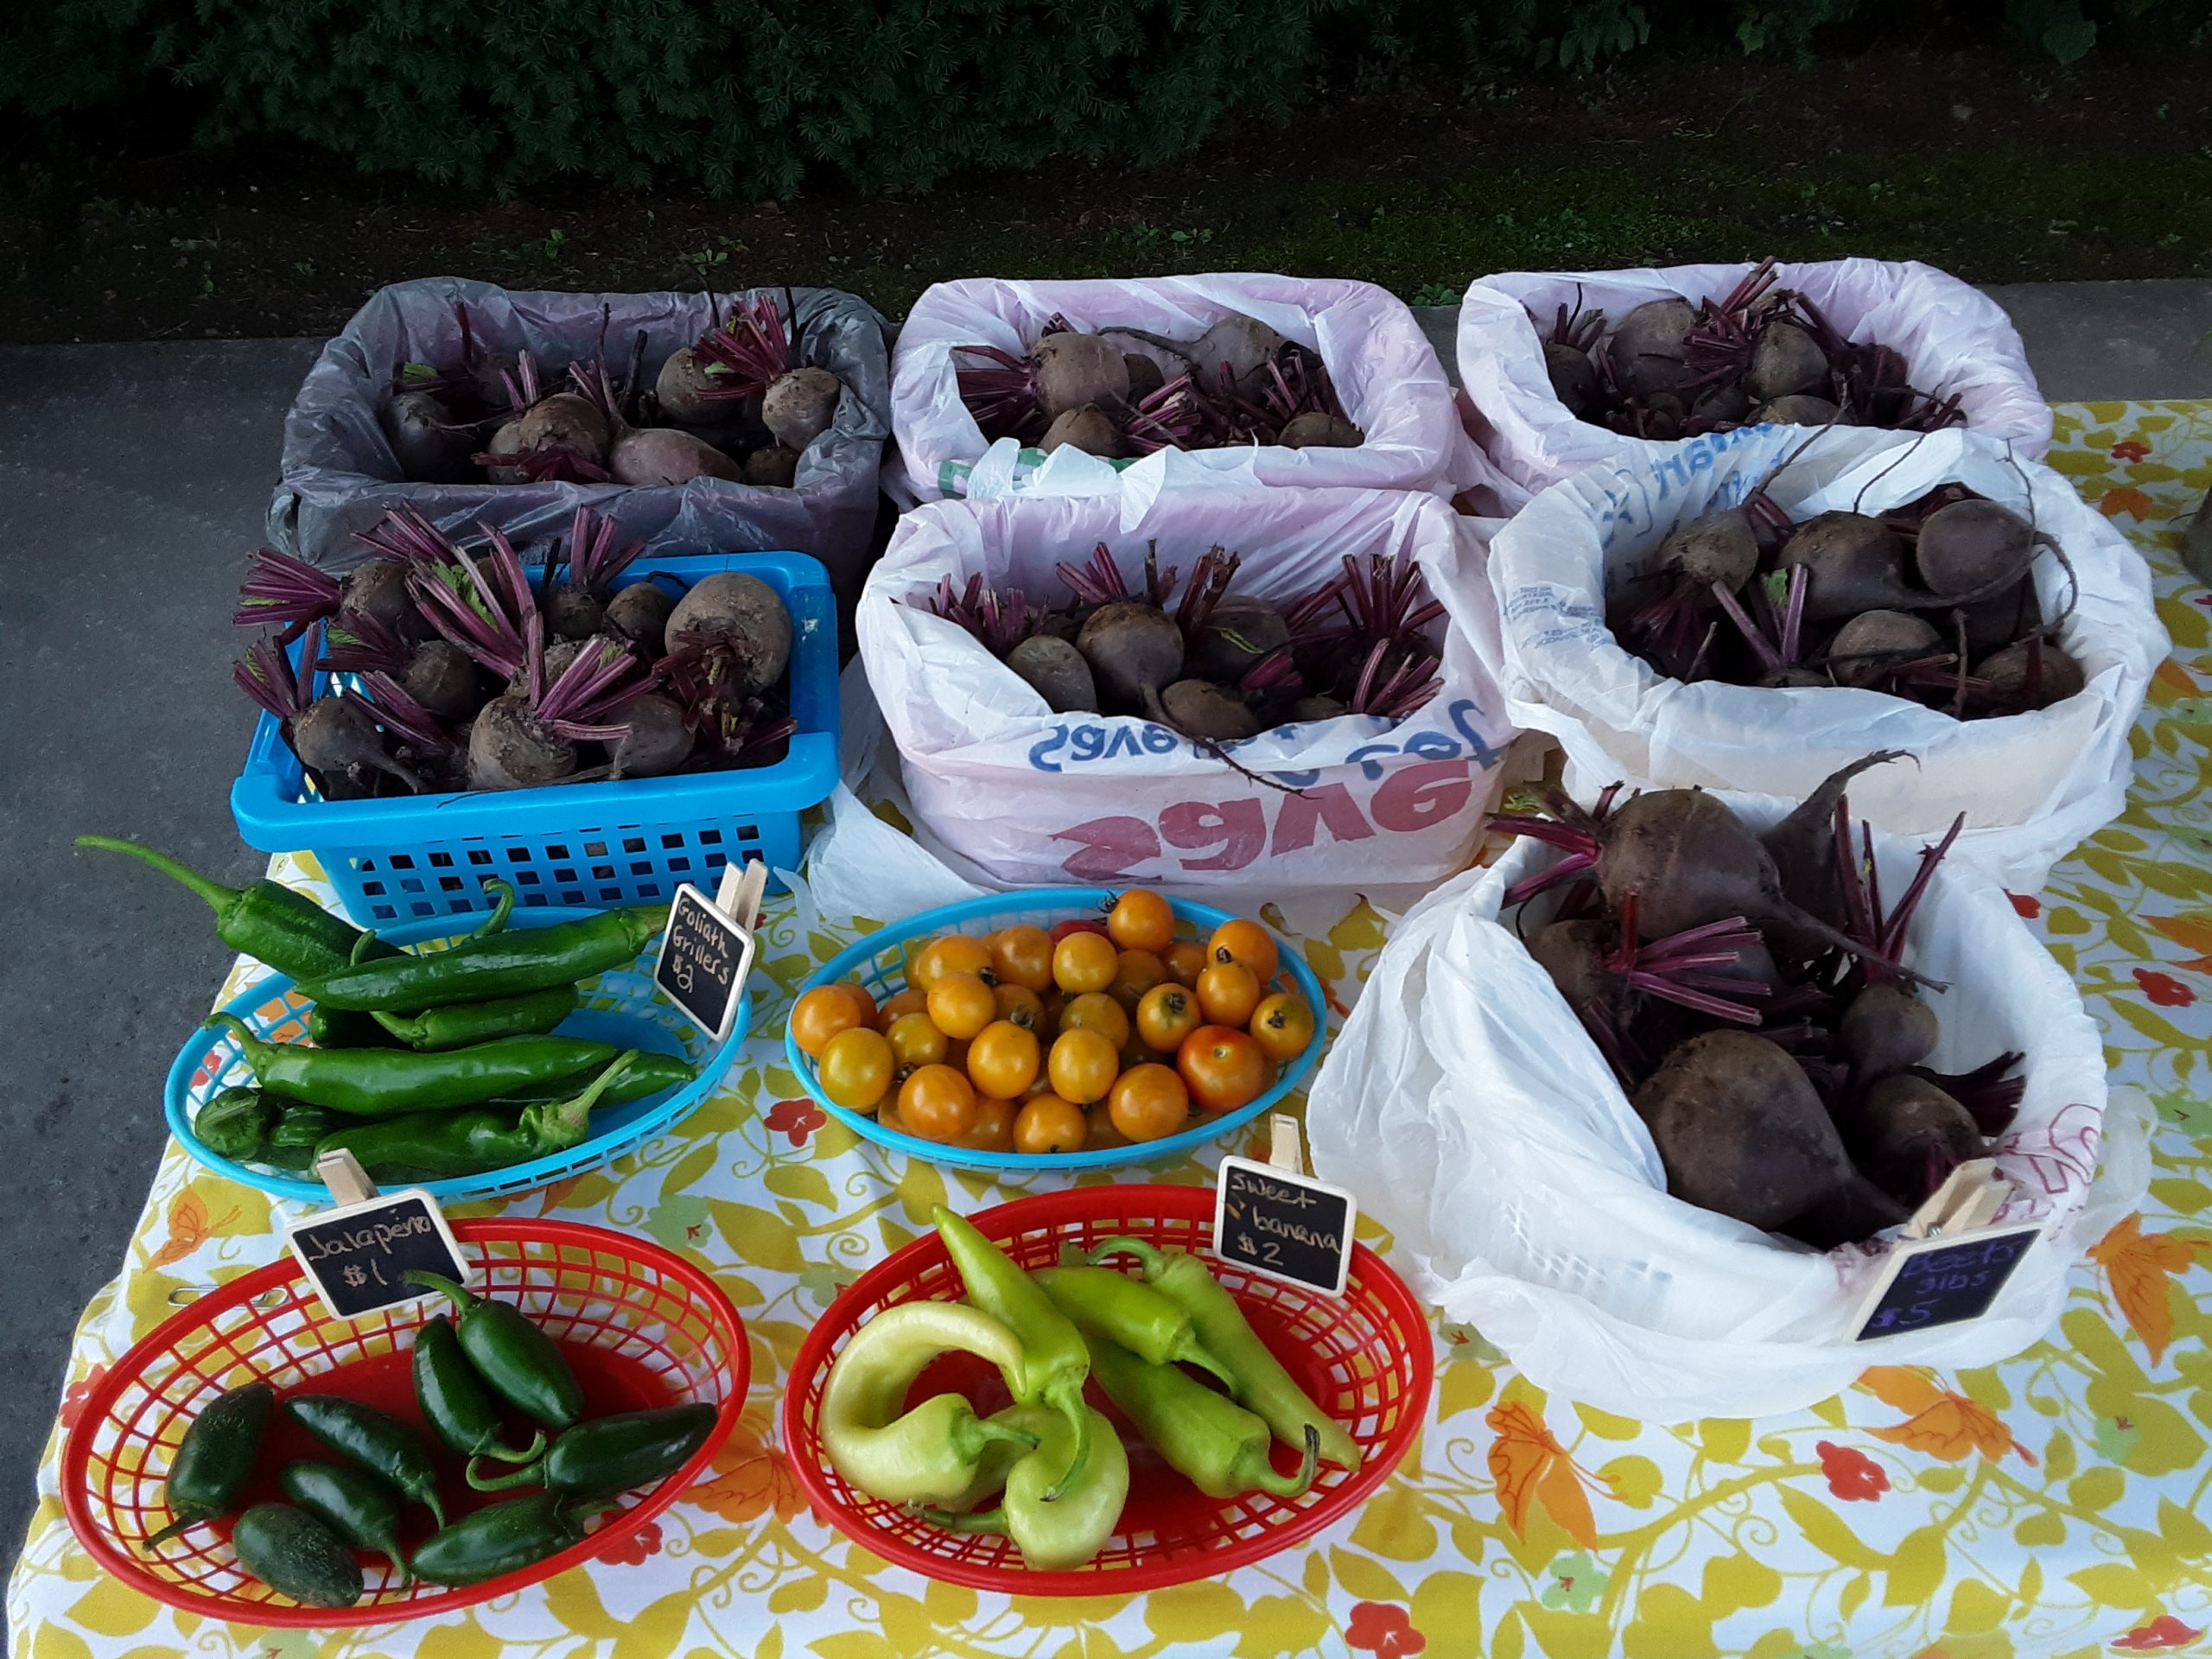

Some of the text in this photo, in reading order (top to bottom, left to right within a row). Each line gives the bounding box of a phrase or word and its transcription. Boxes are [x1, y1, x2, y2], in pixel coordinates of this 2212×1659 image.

[677, 897, 728, 957] Goliath
[671, 925, 730, 985] Grillers
[1237, 1232, 1284, 1266] $2
[1252, 1205, 1341, 1254] banana
[341, 1258, 388, 1287] $1
